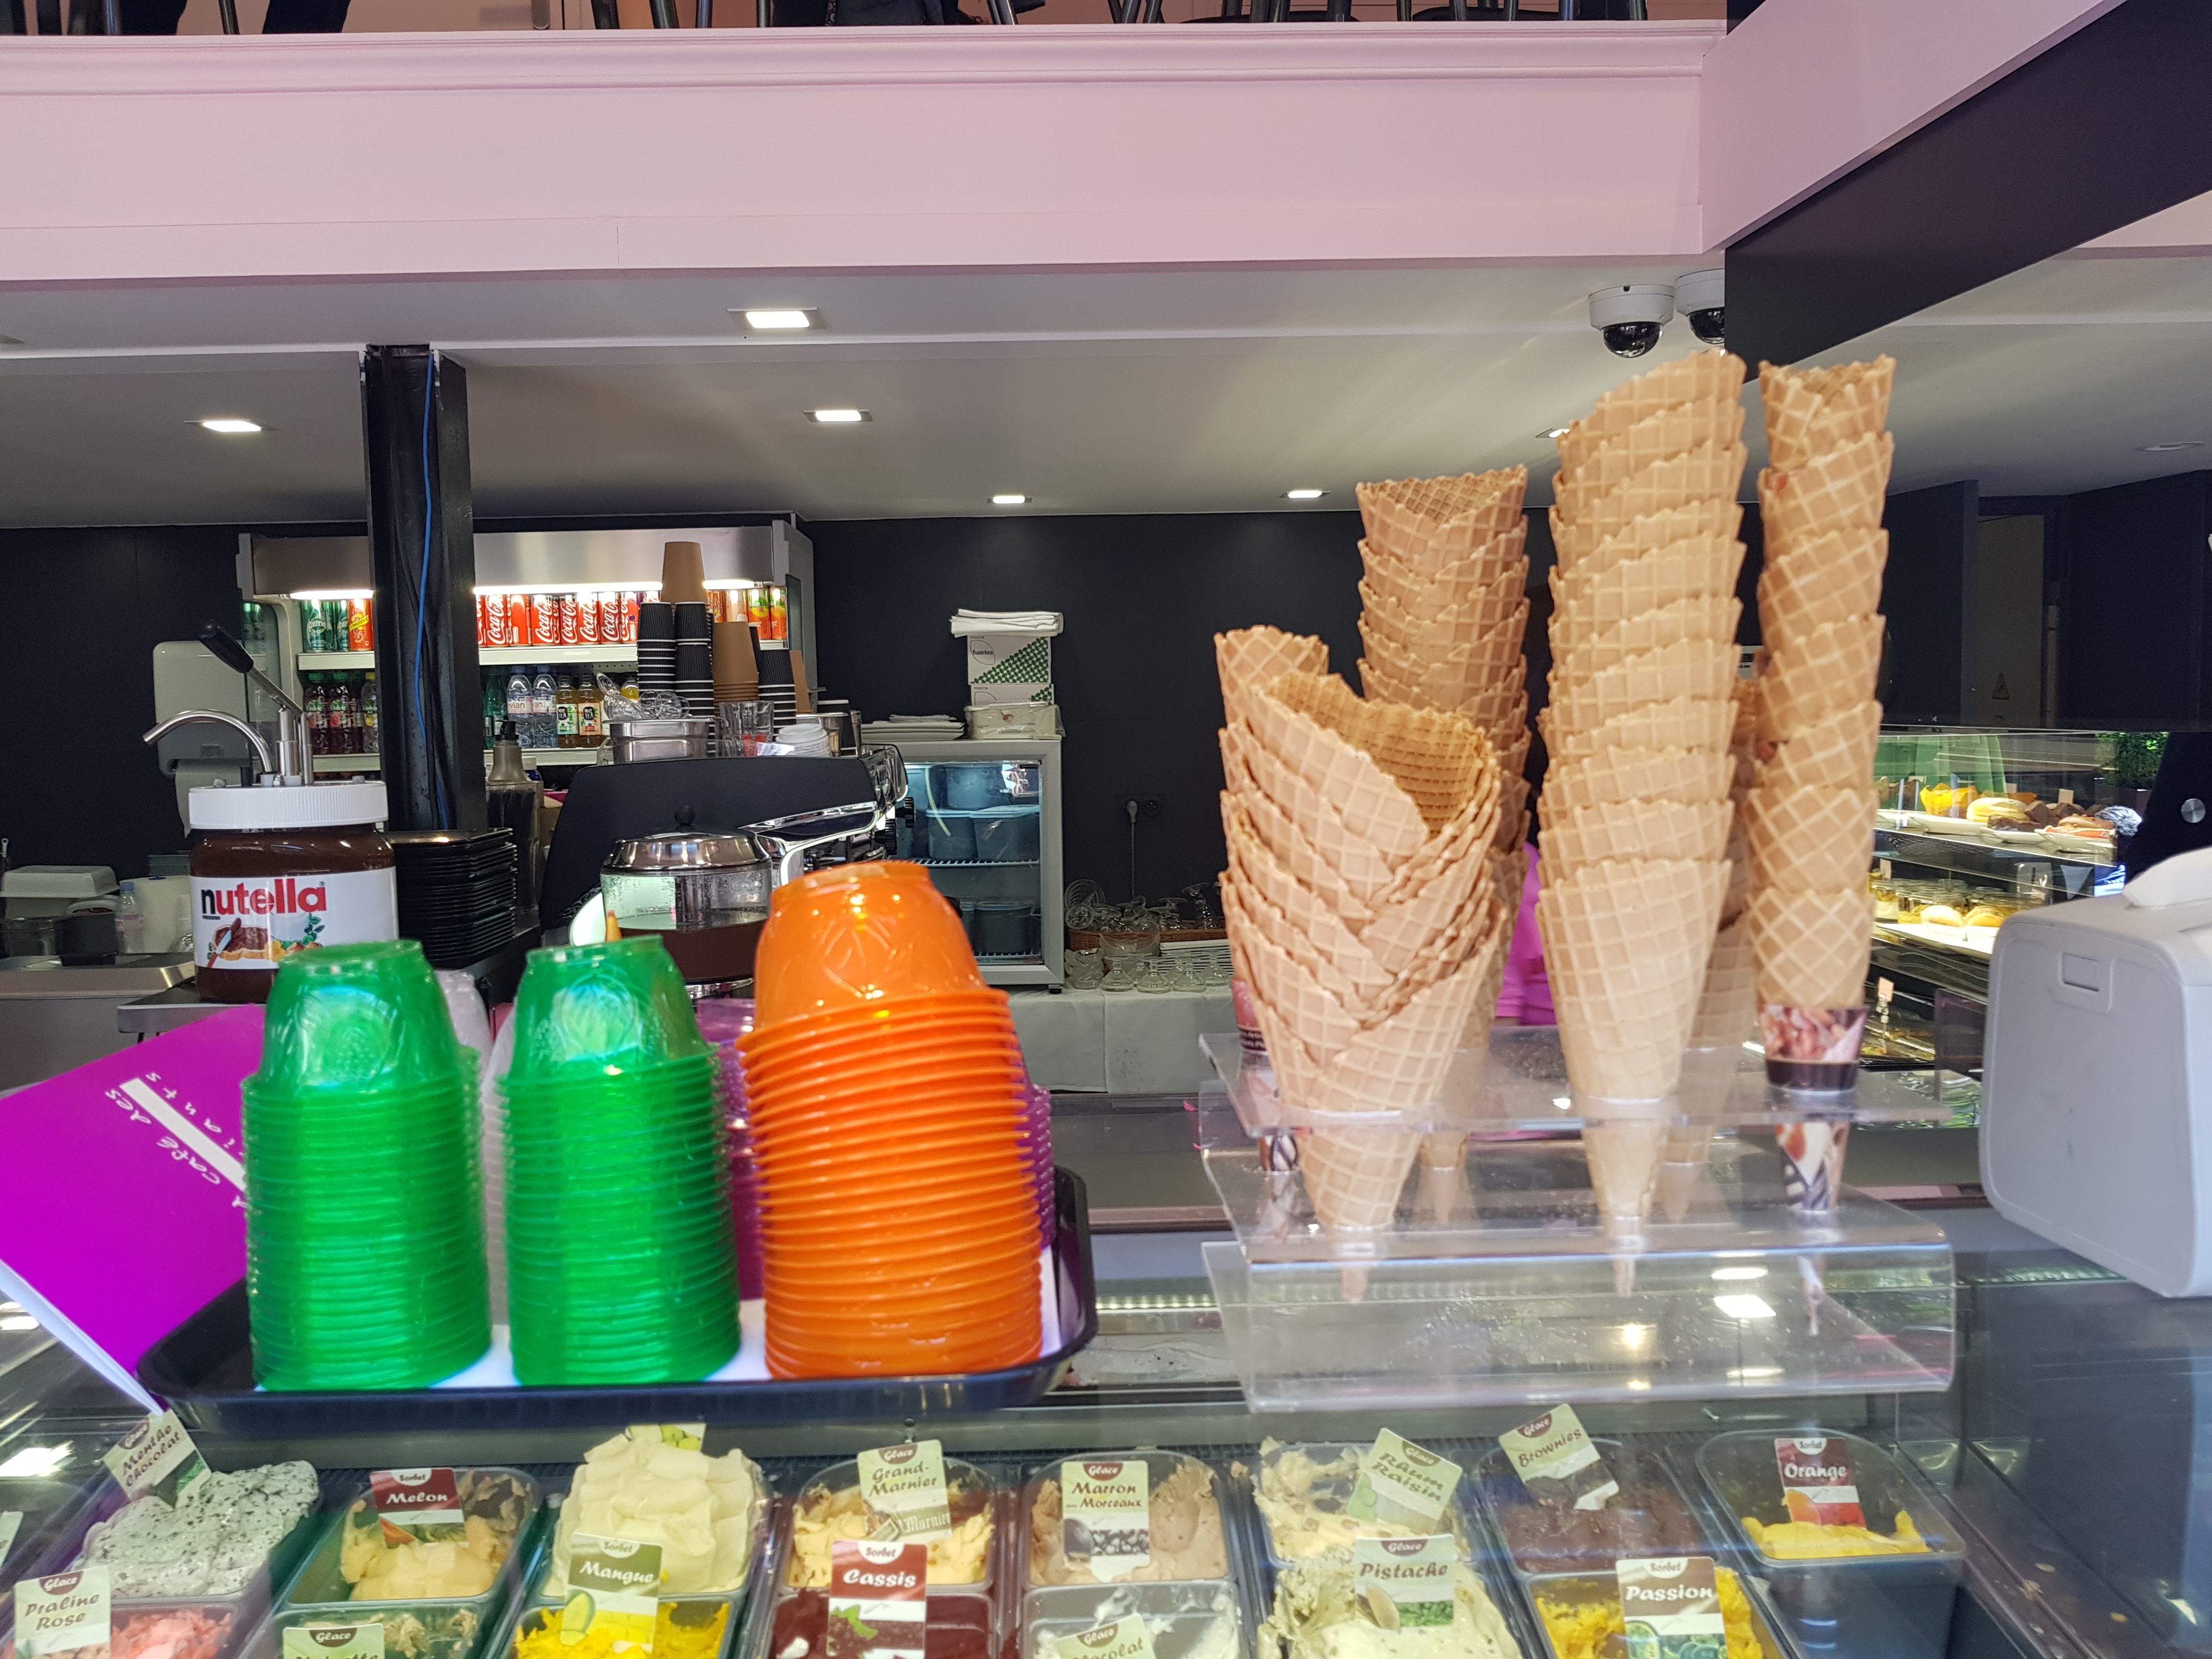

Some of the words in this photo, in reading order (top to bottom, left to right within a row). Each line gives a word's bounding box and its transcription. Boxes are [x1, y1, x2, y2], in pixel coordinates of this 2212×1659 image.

[201, 878, 326, 915] nutella
[105, 1089, 152, 1124] des
[156, 1136, 221, 1185] café
[122, 1425, 172, 1476] Menthe
[884, 1449, 913, 1462] Glace
[1518, 1428, 1582, 1468] Brownies
[126, 1431, 180, 1487] Chocolat
[872, 1460, 929, 1483] Grand-
[1088, 1465, 1119, 1476] Glace
[1379, 1452, 1444, 1491] Rhum
[1784, 1462, 1847, 1481] Orange
[868, 1476, 937, 1497] Marnier
[1071, 1482, 1136, 1494] Marron
[1372, 1461, 1441, 1502] Raisin
[385, 1492, 448, 1504] Melon
[1080, 1497, 1142, 1508] Morceaux
[866, 1547, 896, 1557] Sorbet
[579, 1560, 654, 1585] Mangue
[843, 1568, 917, 1588] Cassis
[1359, 1562, 1448, 1580] Pistache
[44, 1576, 78, 1591] Glace
[1625, 1583, 1713, 1601] Passion
[25, 1594, 100, 1617] Praline
[35, 1612, 87, 1631] Rose
[315, 1632, 351, 1643] Glace
[1083, 1628, 1115, 1645] Glace
[1072, 1637, 1143, 1659] colat
